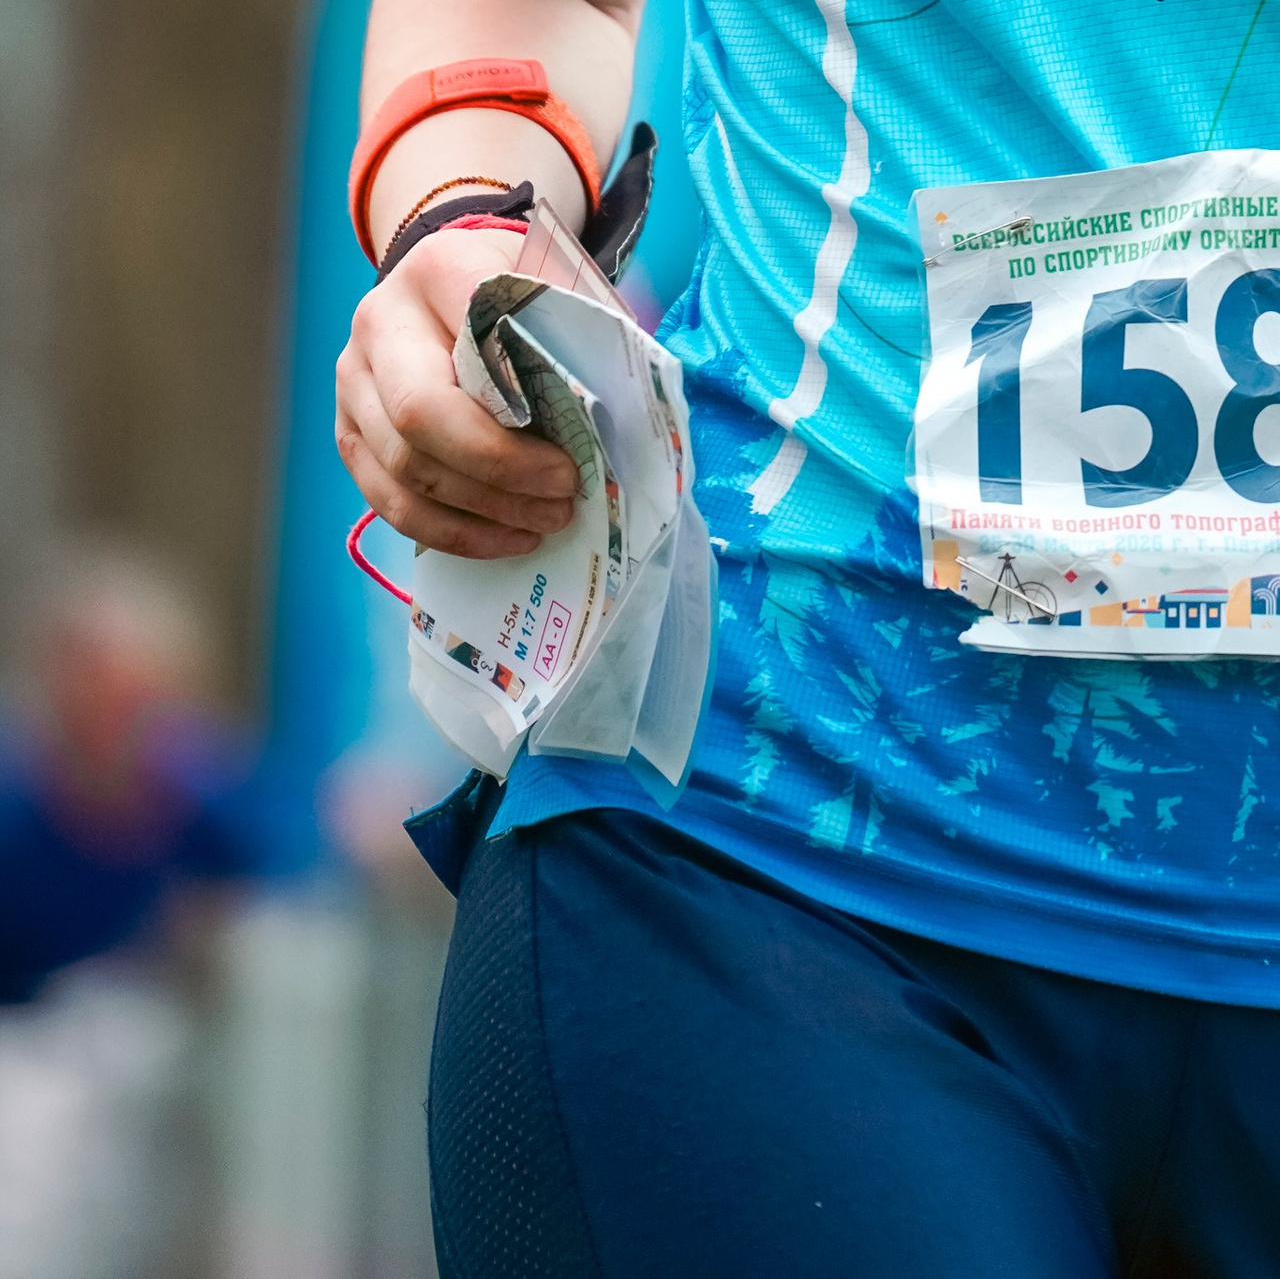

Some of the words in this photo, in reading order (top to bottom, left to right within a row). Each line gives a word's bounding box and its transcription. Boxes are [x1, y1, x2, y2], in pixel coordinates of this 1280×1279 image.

[1140, 196, 1279, 230] СПОРТИВНЫЕ
[1008, 256, 1036, 279] ПО
[1044, 230, 1192, 274] СПОРТИВНОМУ
[951, 508, 1042, 530] Памяти
[1051, 512, 1161, 534] военного
[530, 573, 547, 608] 500
[521, 608, 536, 637] 1:7
[514, 641, 529, 661] М
